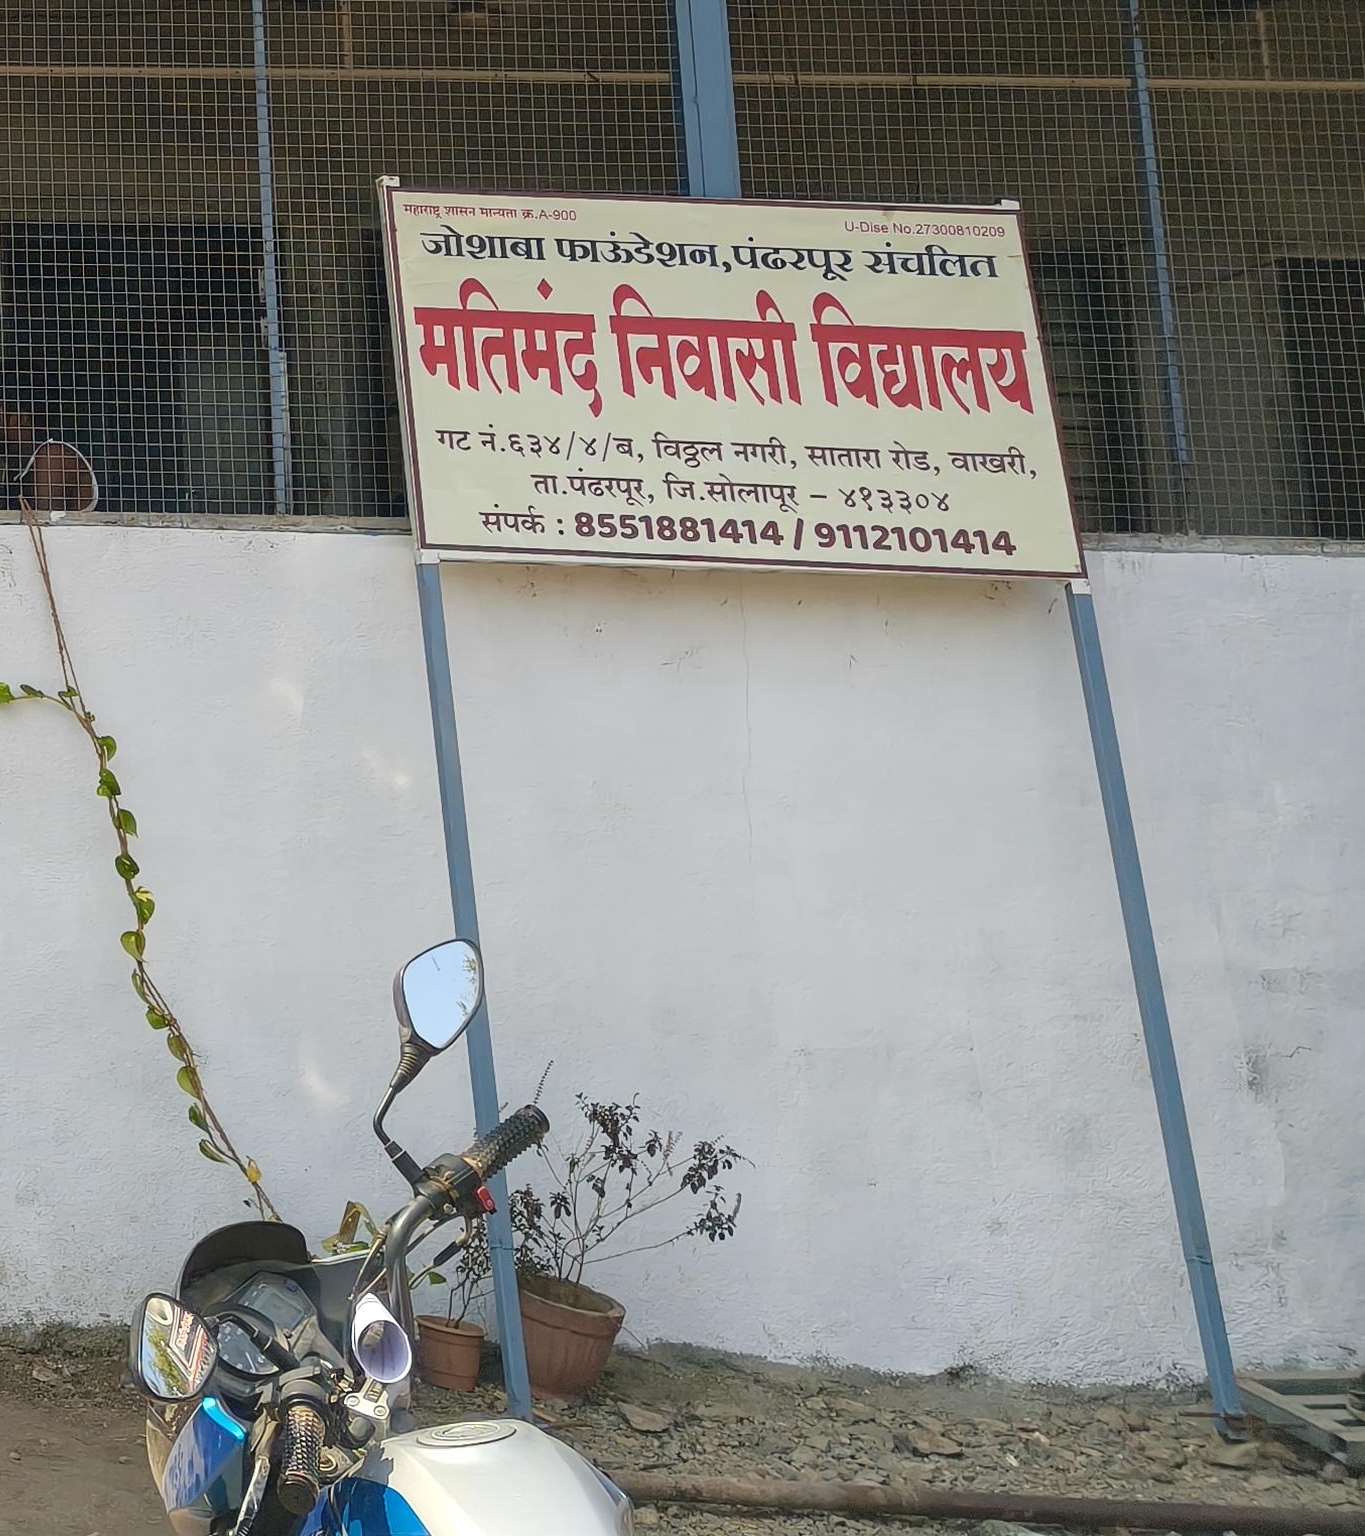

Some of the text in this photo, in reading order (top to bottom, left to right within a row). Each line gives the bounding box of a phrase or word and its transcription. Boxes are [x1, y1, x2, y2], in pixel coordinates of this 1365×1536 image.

[402, 203, 442, 220] महाराष्ट्र
[444, 205, 476, 218] शासन
[479, 207, 518, 220] मान्यता
[844, 220, 1006, 239] U-Dise No.27300810209
[419, 224, 546, 261] जोशाबा
[861, 241, 1000, 279] संचलित
[413, 277, 1036, 419] मतिमंद निवासी विद्यालय
[434, 429, 472, 452] गट
[650, 430, 724, 468] विठ्ठल
[730, 436, 797, 469] नगरी,
[803, 444, 882, 470] सातारा
[888, 440, 941, 476] रोड,
[946, 445, 1038, 480] वाखरी,
[837, 485, 951, 515] ४१३३०४
[478, 503, 546, 535] संपर्क
[574, 511, 785, 547] 8551881414
[813, 521, 1018, 557] 9112101414
